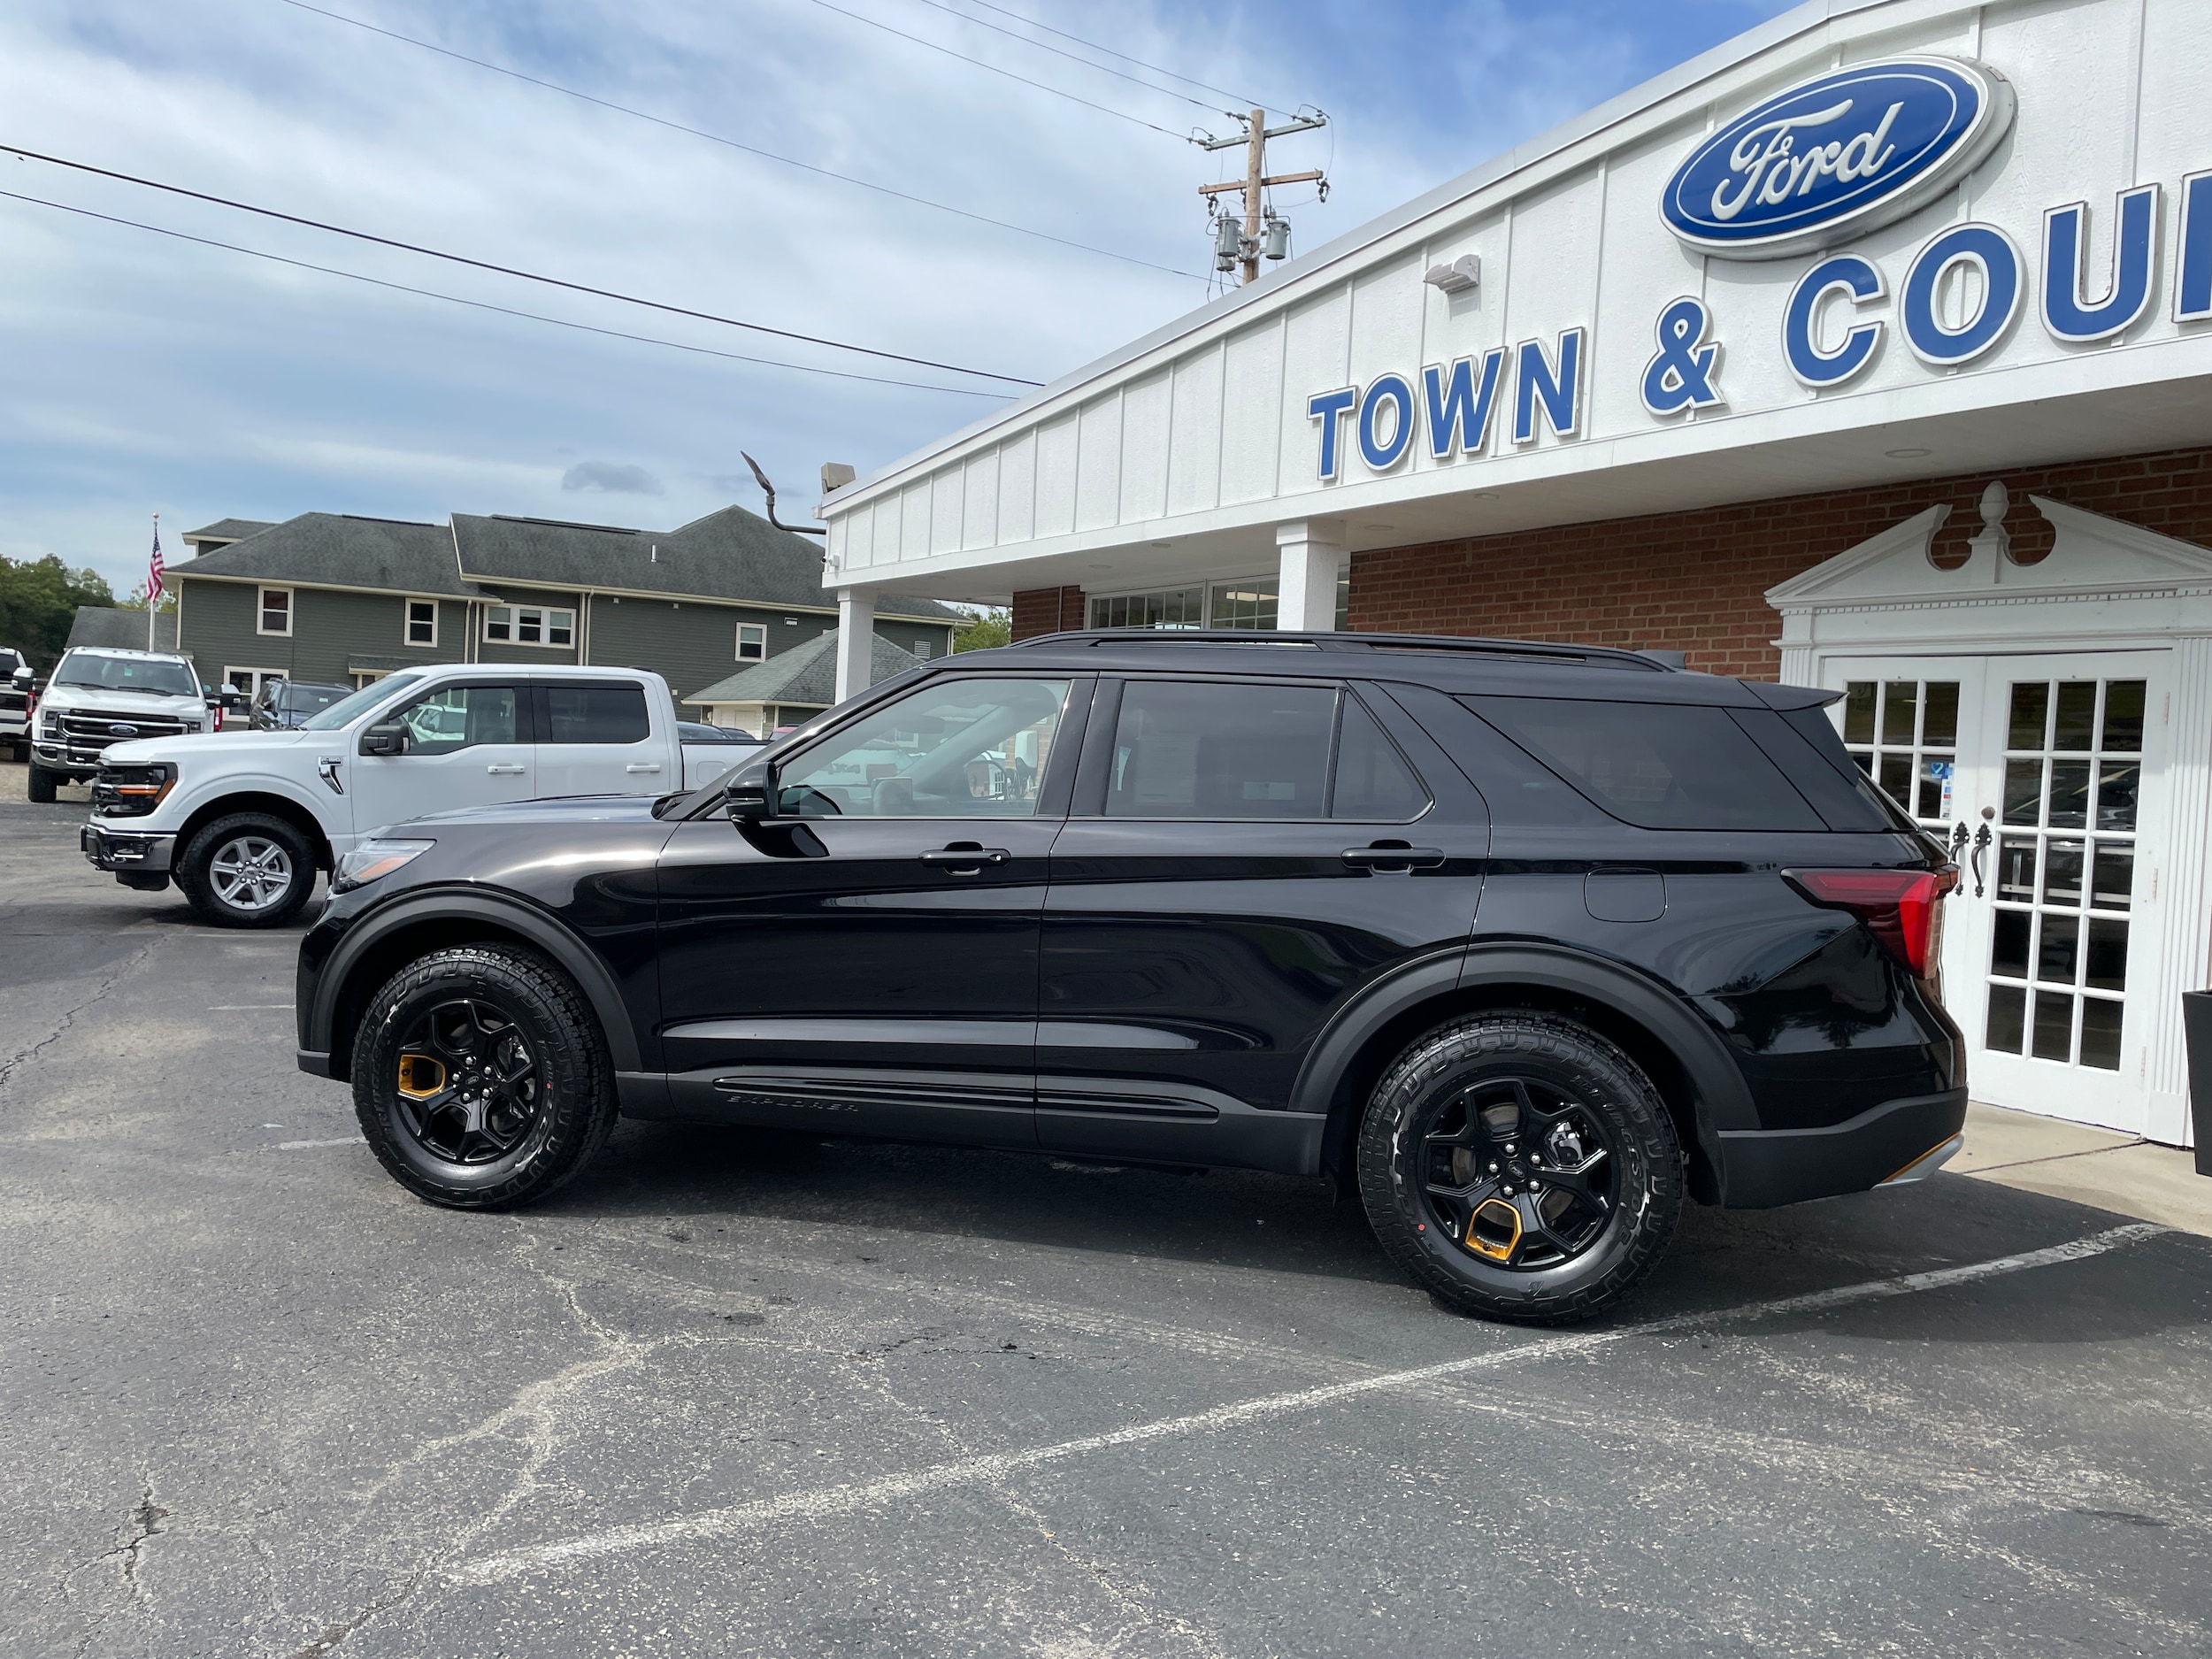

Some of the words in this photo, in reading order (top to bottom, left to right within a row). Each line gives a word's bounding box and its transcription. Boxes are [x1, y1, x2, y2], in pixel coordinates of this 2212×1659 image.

[1711, 99, 1904, 220] Ford
[1307, 326, 1585, 480] TOWN
[1640, 296, 1724, 416] &
